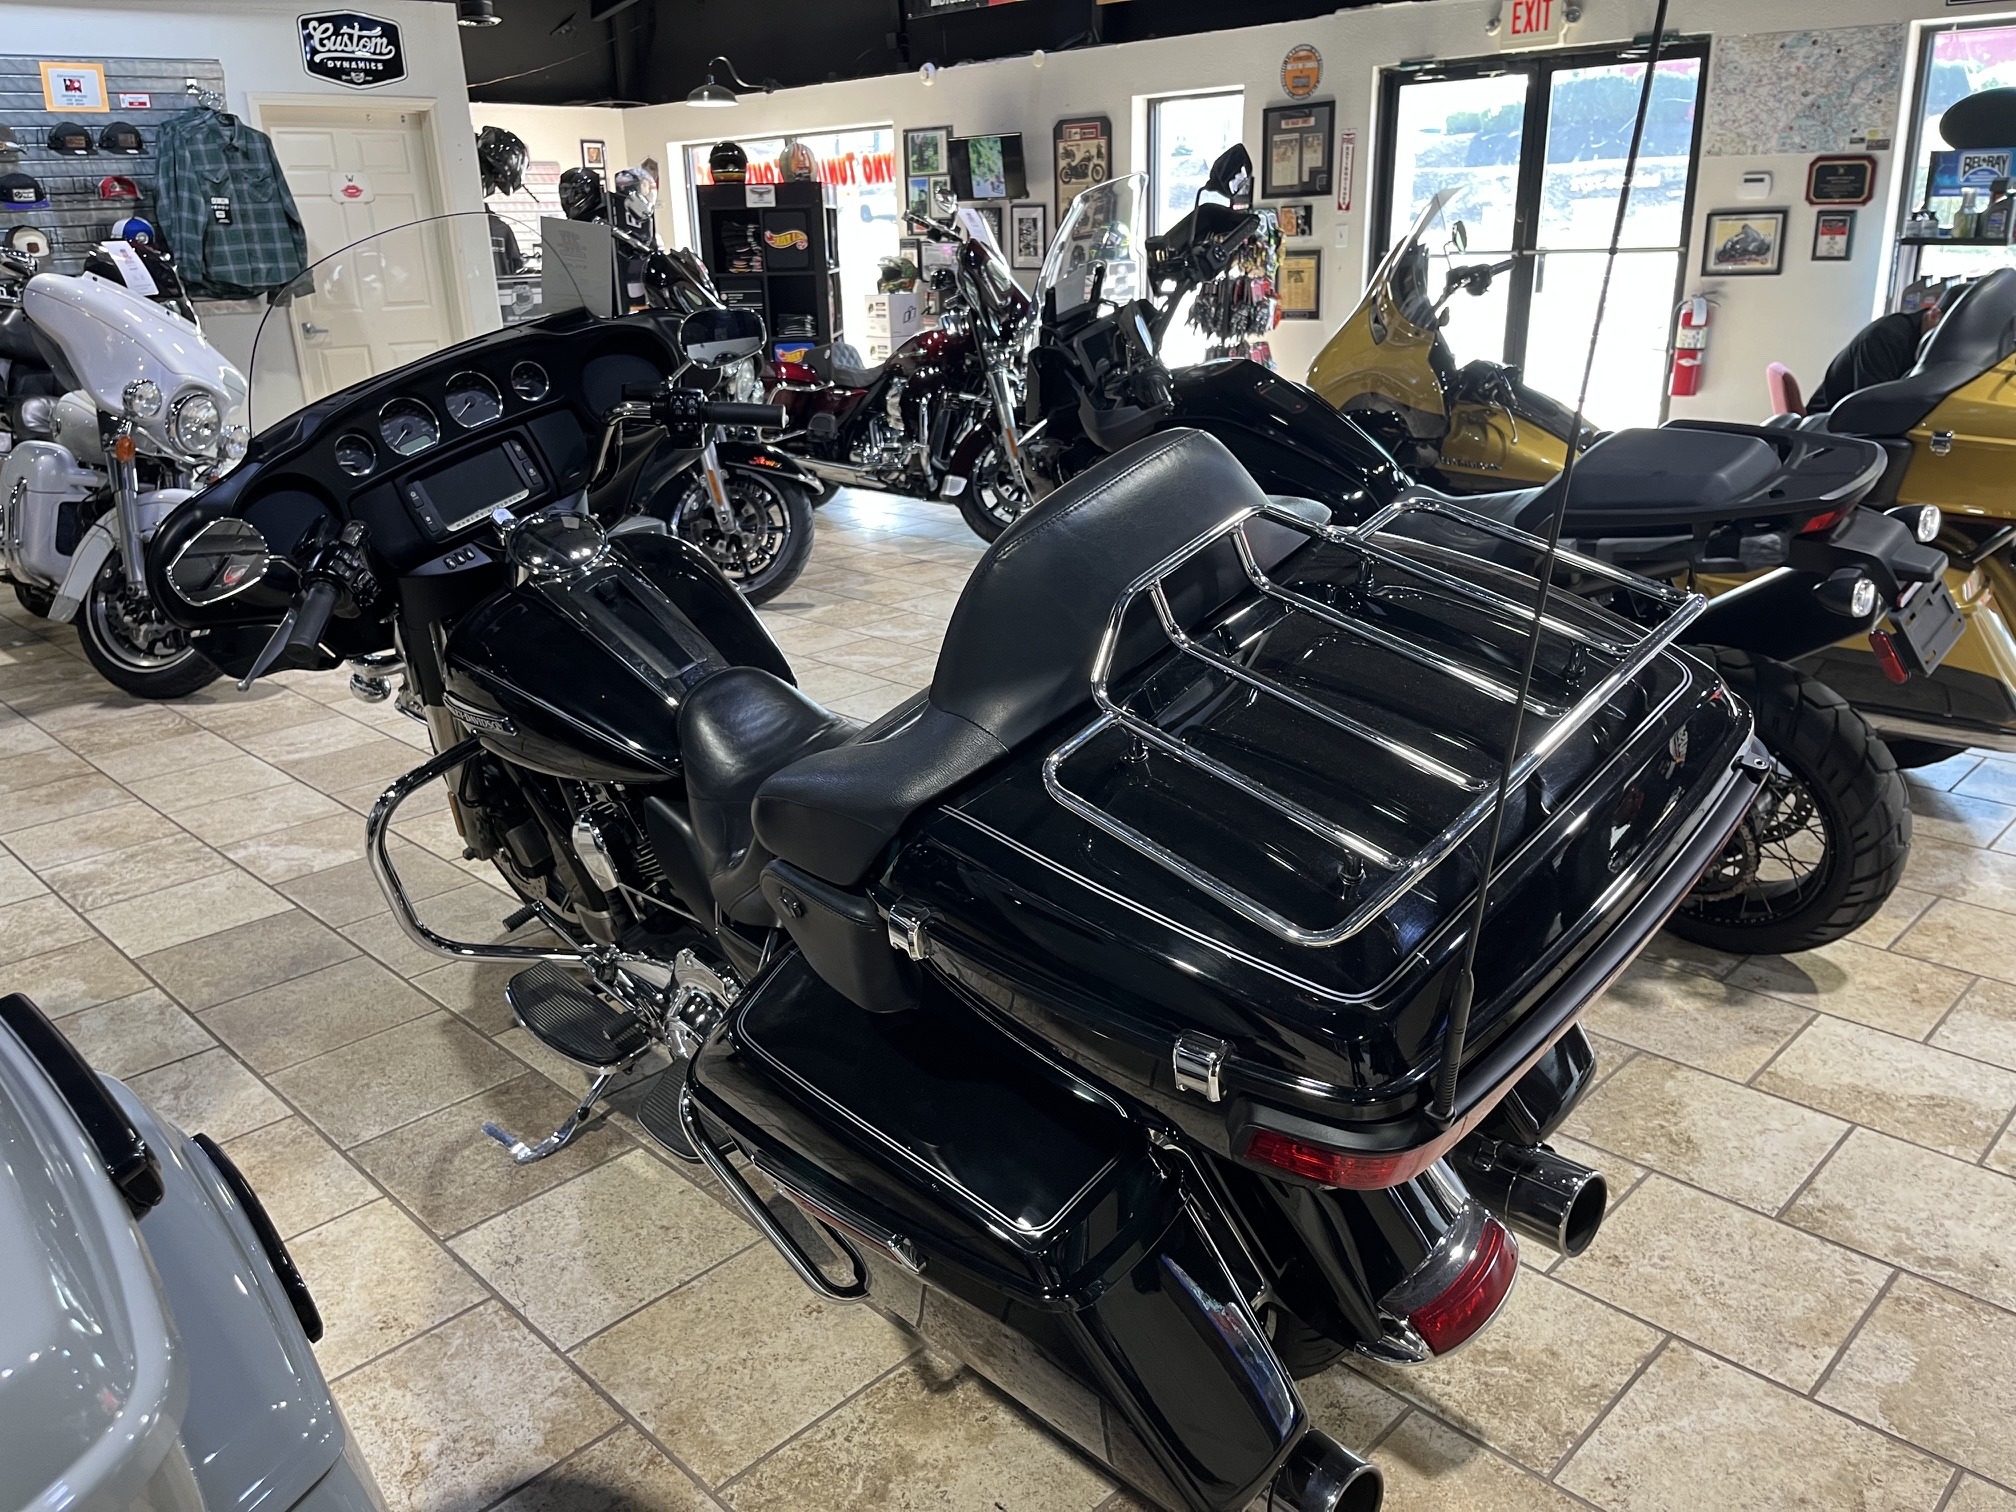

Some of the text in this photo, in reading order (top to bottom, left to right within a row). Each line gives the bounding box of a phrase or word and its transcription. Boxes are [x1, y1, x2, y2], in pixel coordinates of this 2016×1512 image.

[1511, 0, 1553, 35] EXIT
[308, 20, 395, 62] Custom
[326, 60, 383, 70] DYNAMICS
